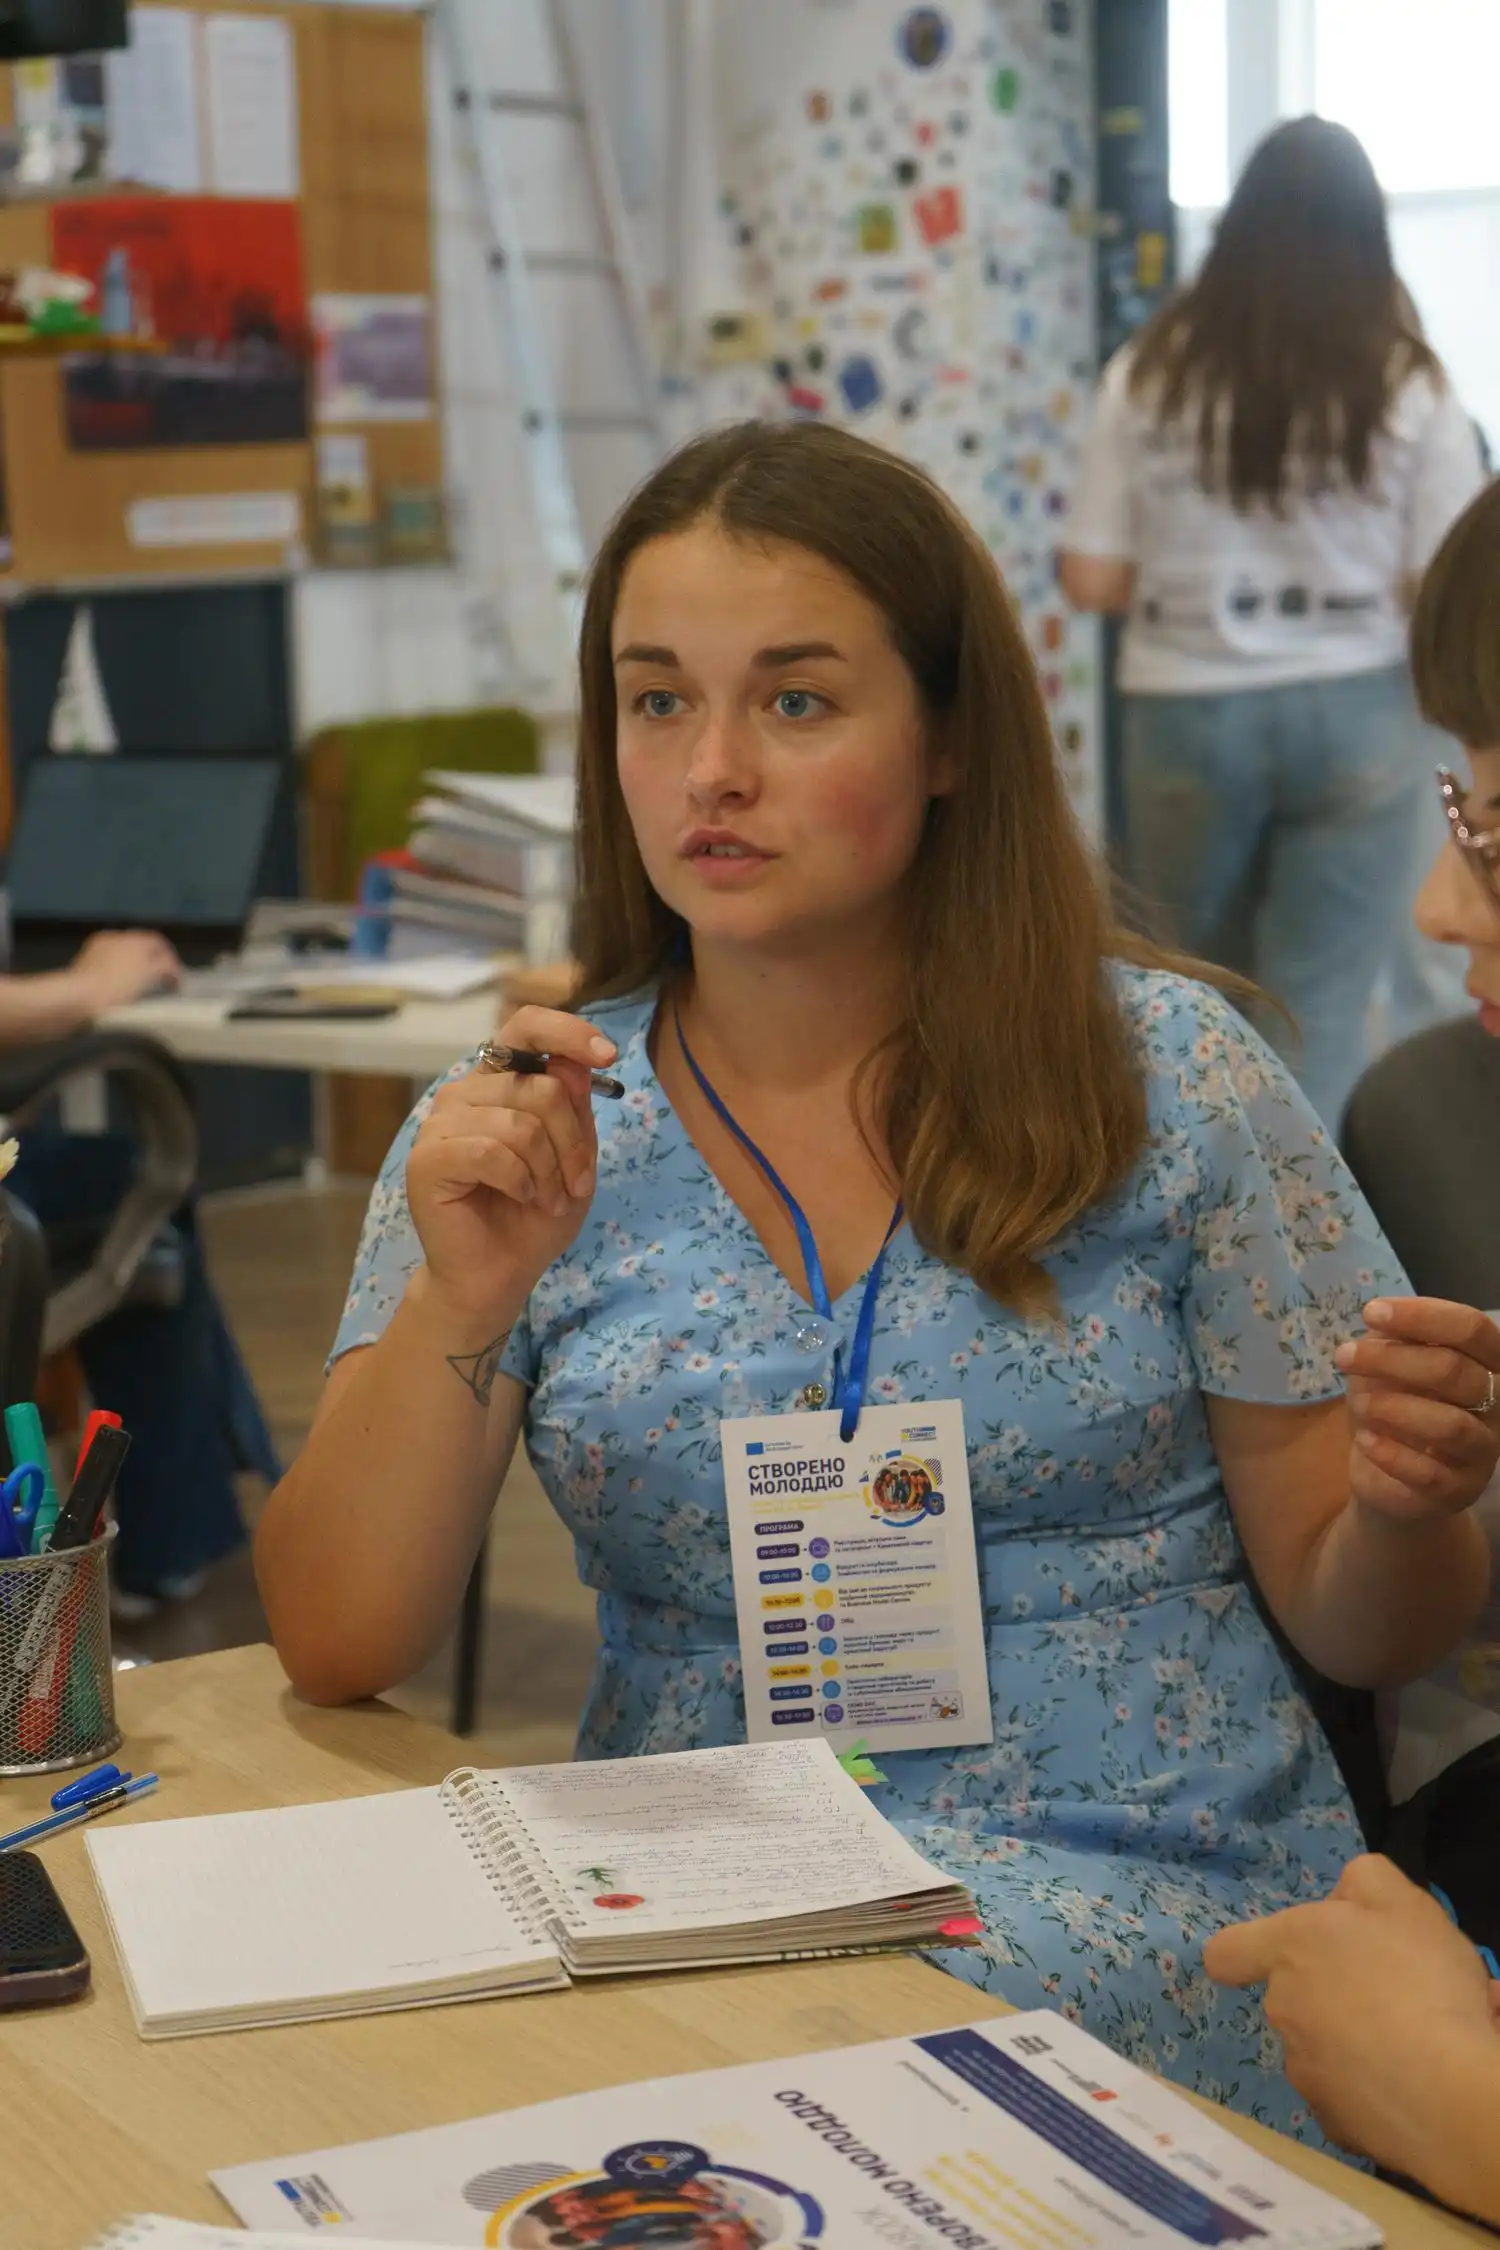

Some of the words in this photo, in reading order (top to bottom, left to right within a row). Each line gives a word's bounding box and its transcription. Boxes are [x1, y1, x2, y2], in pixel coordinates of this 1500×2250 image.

[748, 1457, 846, 1480] СТВОРЕНО
[750, 1474, 844, 1496] МОЛОДДЮ
[759, 1522, 800, 1533] ПРОГРАМА
[773, 2089, 900, 2181] МОЛОДДЮ
